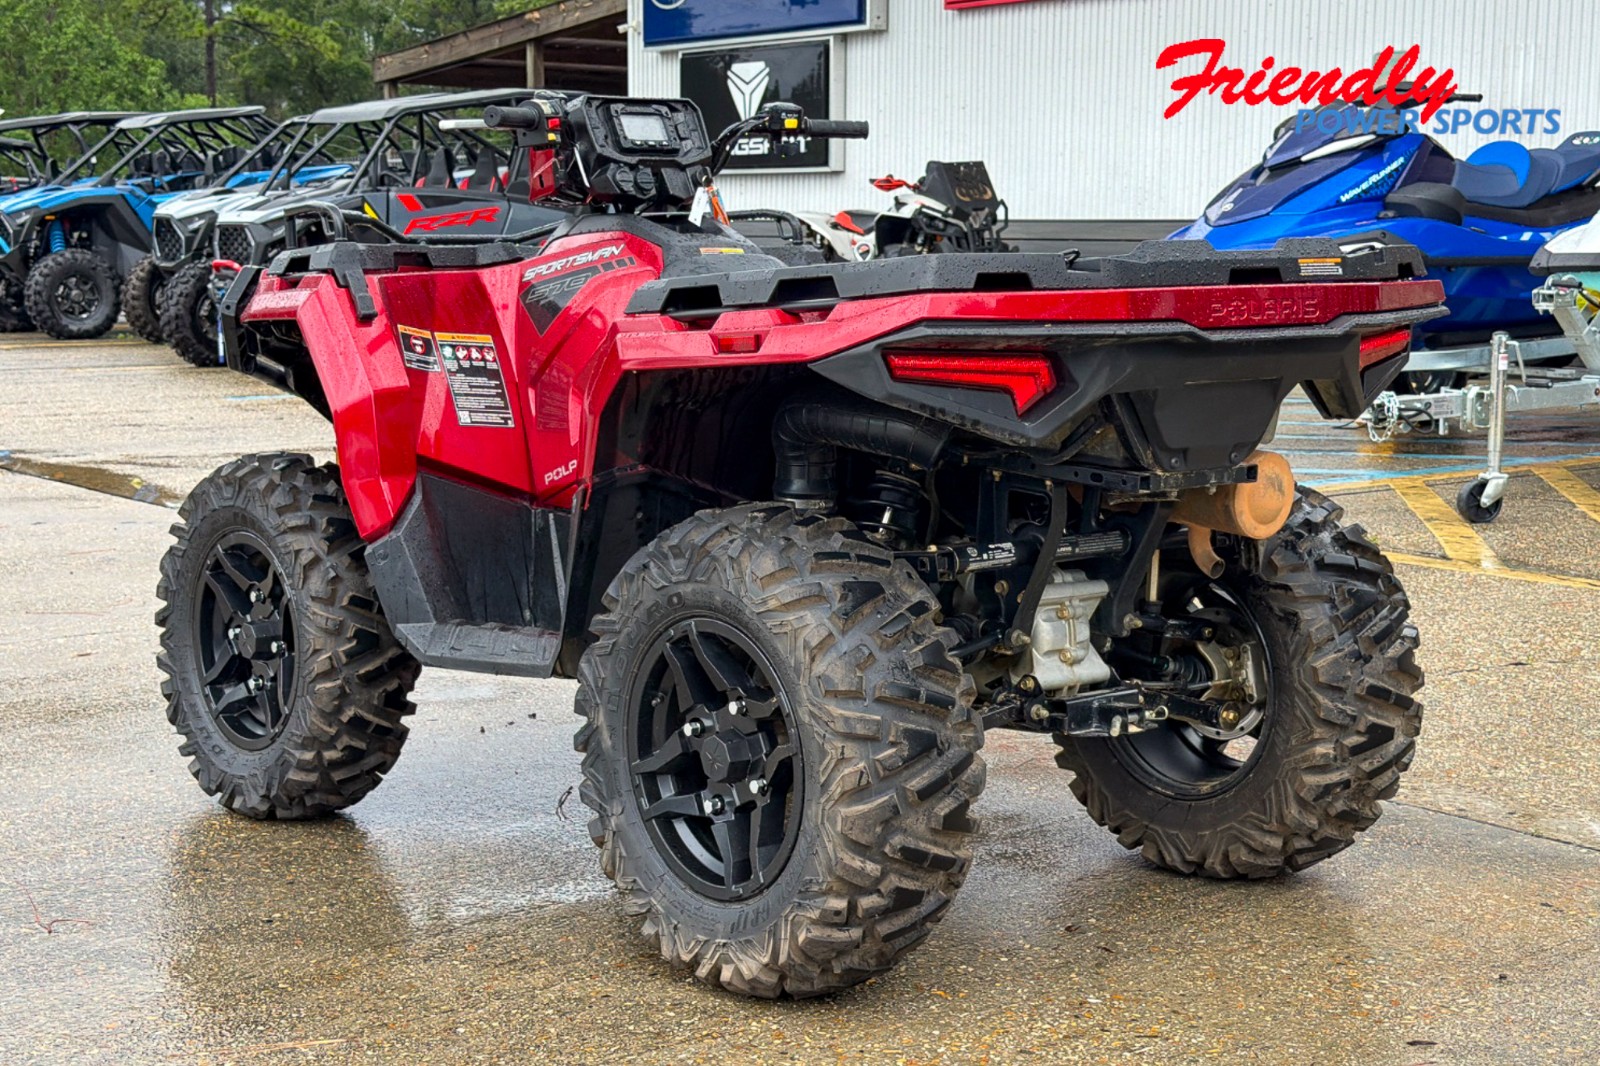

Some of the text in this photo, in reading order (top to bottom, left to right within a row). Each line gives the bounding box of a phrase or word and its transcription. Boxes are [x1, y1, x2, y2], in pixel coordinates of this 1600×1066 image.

[403, 206, 500, 235] RZR
[522, 243, 625, 281] SPORTSMAN
[525, 272, 592, 304] 570
[1208, 299, 1320, 321] POLARIS
